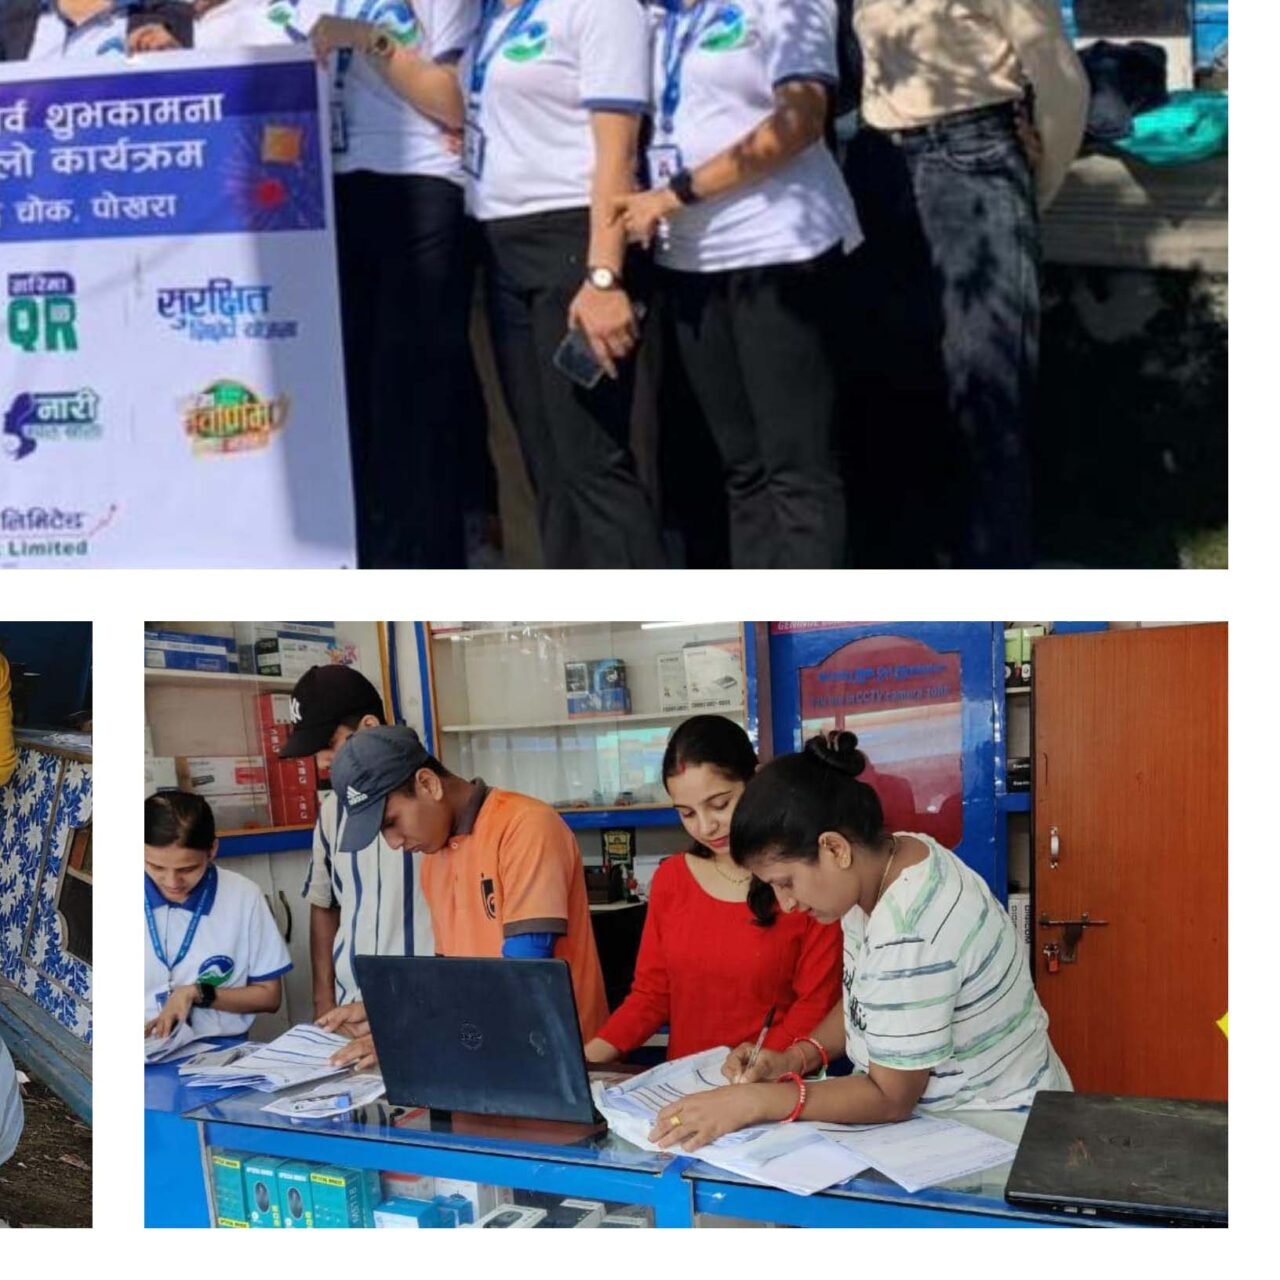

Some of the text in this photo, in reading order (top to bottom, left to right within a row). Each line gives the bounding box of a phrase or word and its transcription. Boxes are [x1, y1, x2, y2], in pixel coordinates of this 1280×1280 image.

[45, 93, 225, 141] शुभकामना
[50, 137, 206, 174] कार्यक्रम
[91, 189, 177, 219] पोखरा
[157, 278, 272, 330] सुरक्षित
[8, 297, 78, 352] QR
[36, 389, 98, 420] नारी
[8, 540, 88, 558] Limited
